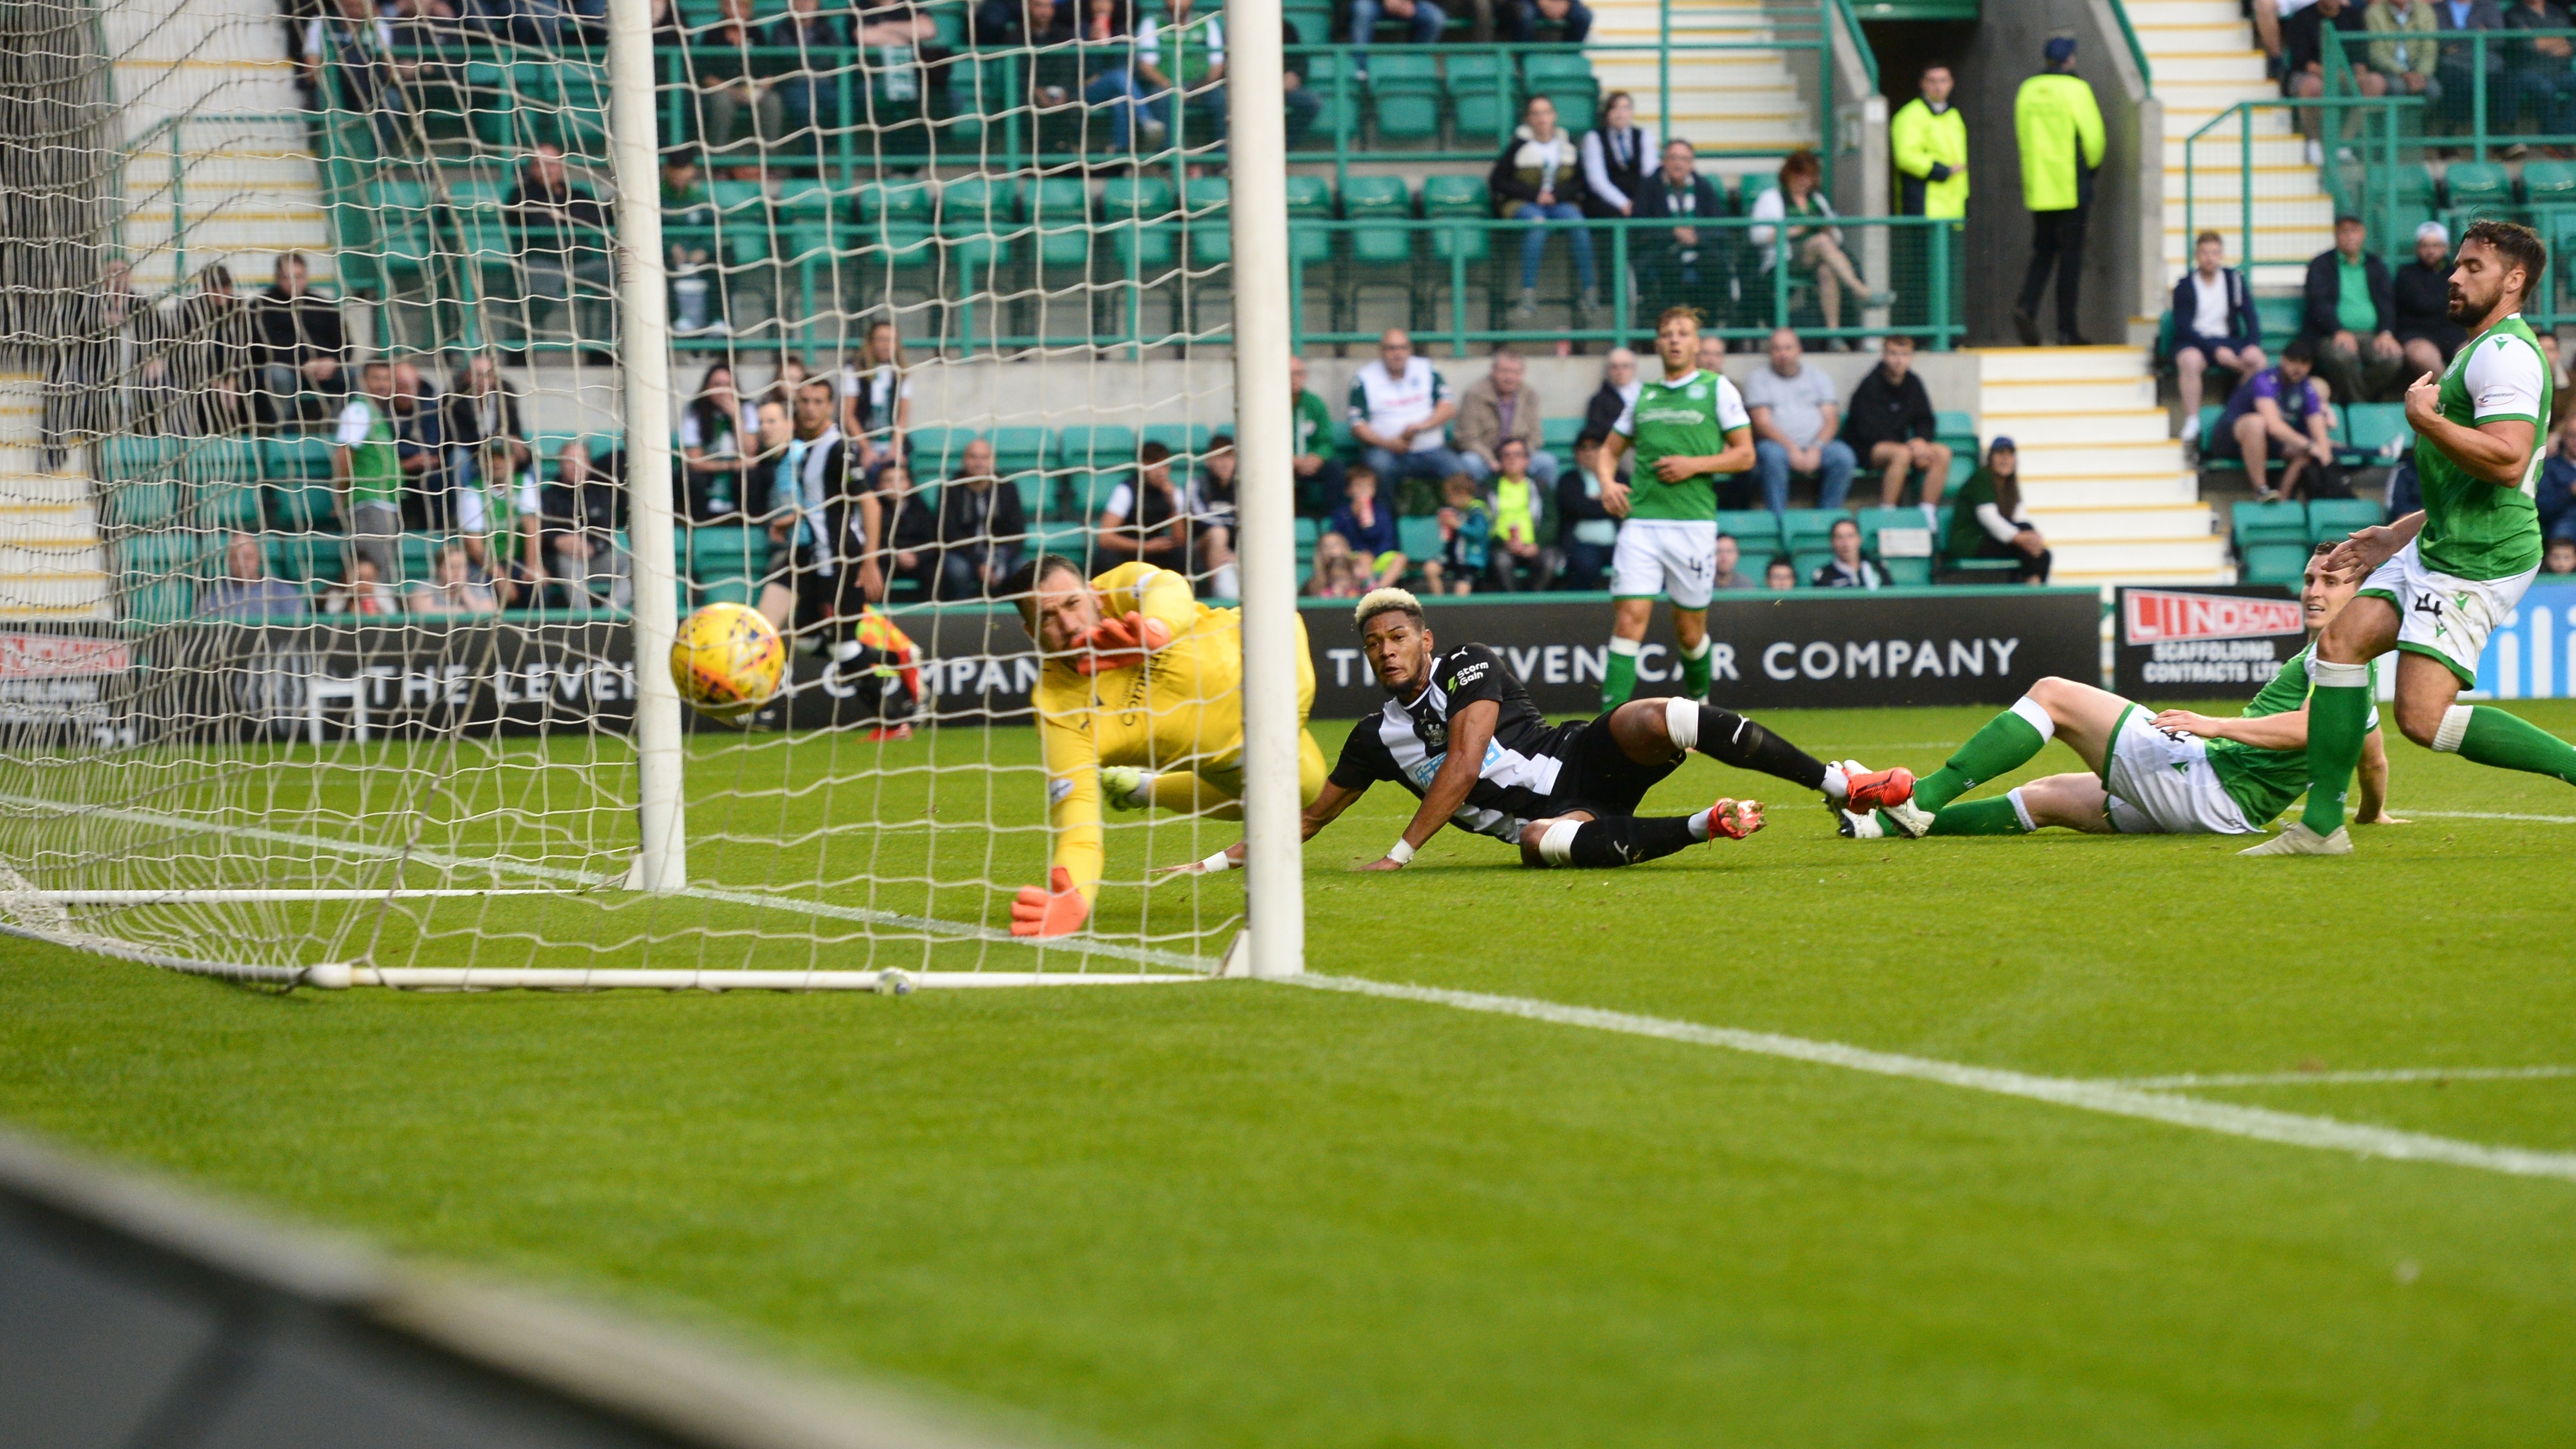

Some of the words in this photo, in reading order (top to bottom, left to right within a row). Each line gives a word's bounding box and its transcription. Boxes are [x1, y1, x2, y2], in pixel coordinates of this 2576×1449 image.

[2130, 596, 2300, 636] LINDSAY
[1762, 637, 2020, 679] COMPANY
[2153, 640, 2275, 661] SCAFFOLDING
[1457, 662, 1489, 679] Storm
[1459, 671, 1484, 686] Gain
[2143, 661, 2249, 682] CONTRACTS
[364, 664, 470, 705] THE
